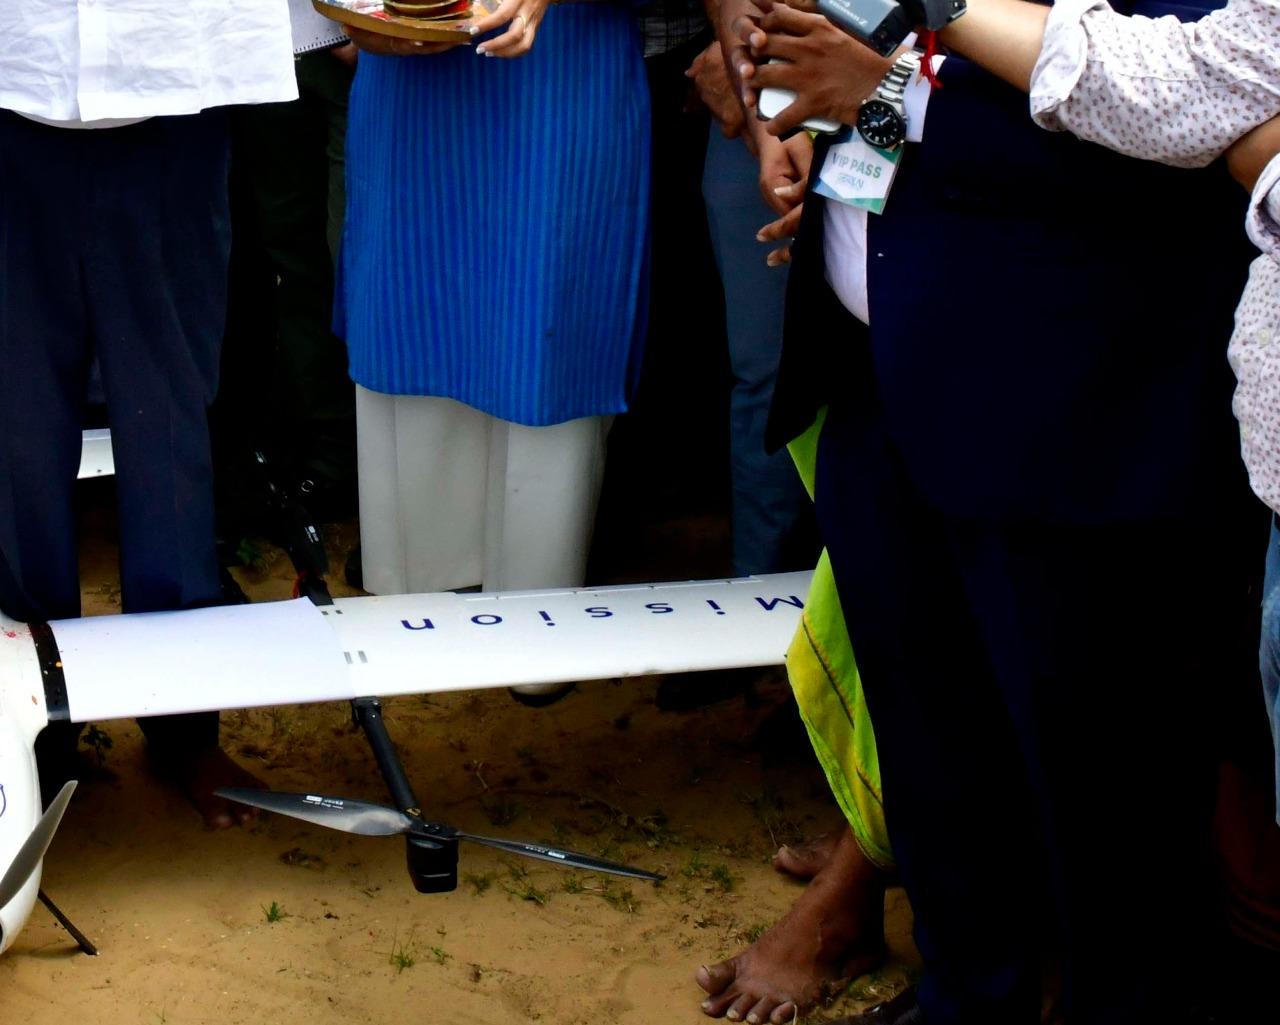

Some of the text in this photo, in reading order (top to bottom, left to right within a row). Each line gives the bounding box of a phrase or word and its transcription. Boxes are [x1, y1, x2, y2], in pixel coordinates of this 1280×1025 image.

[832, 152, 882, 179] VIP PASS
[400, 594, 805, 631] Mission
